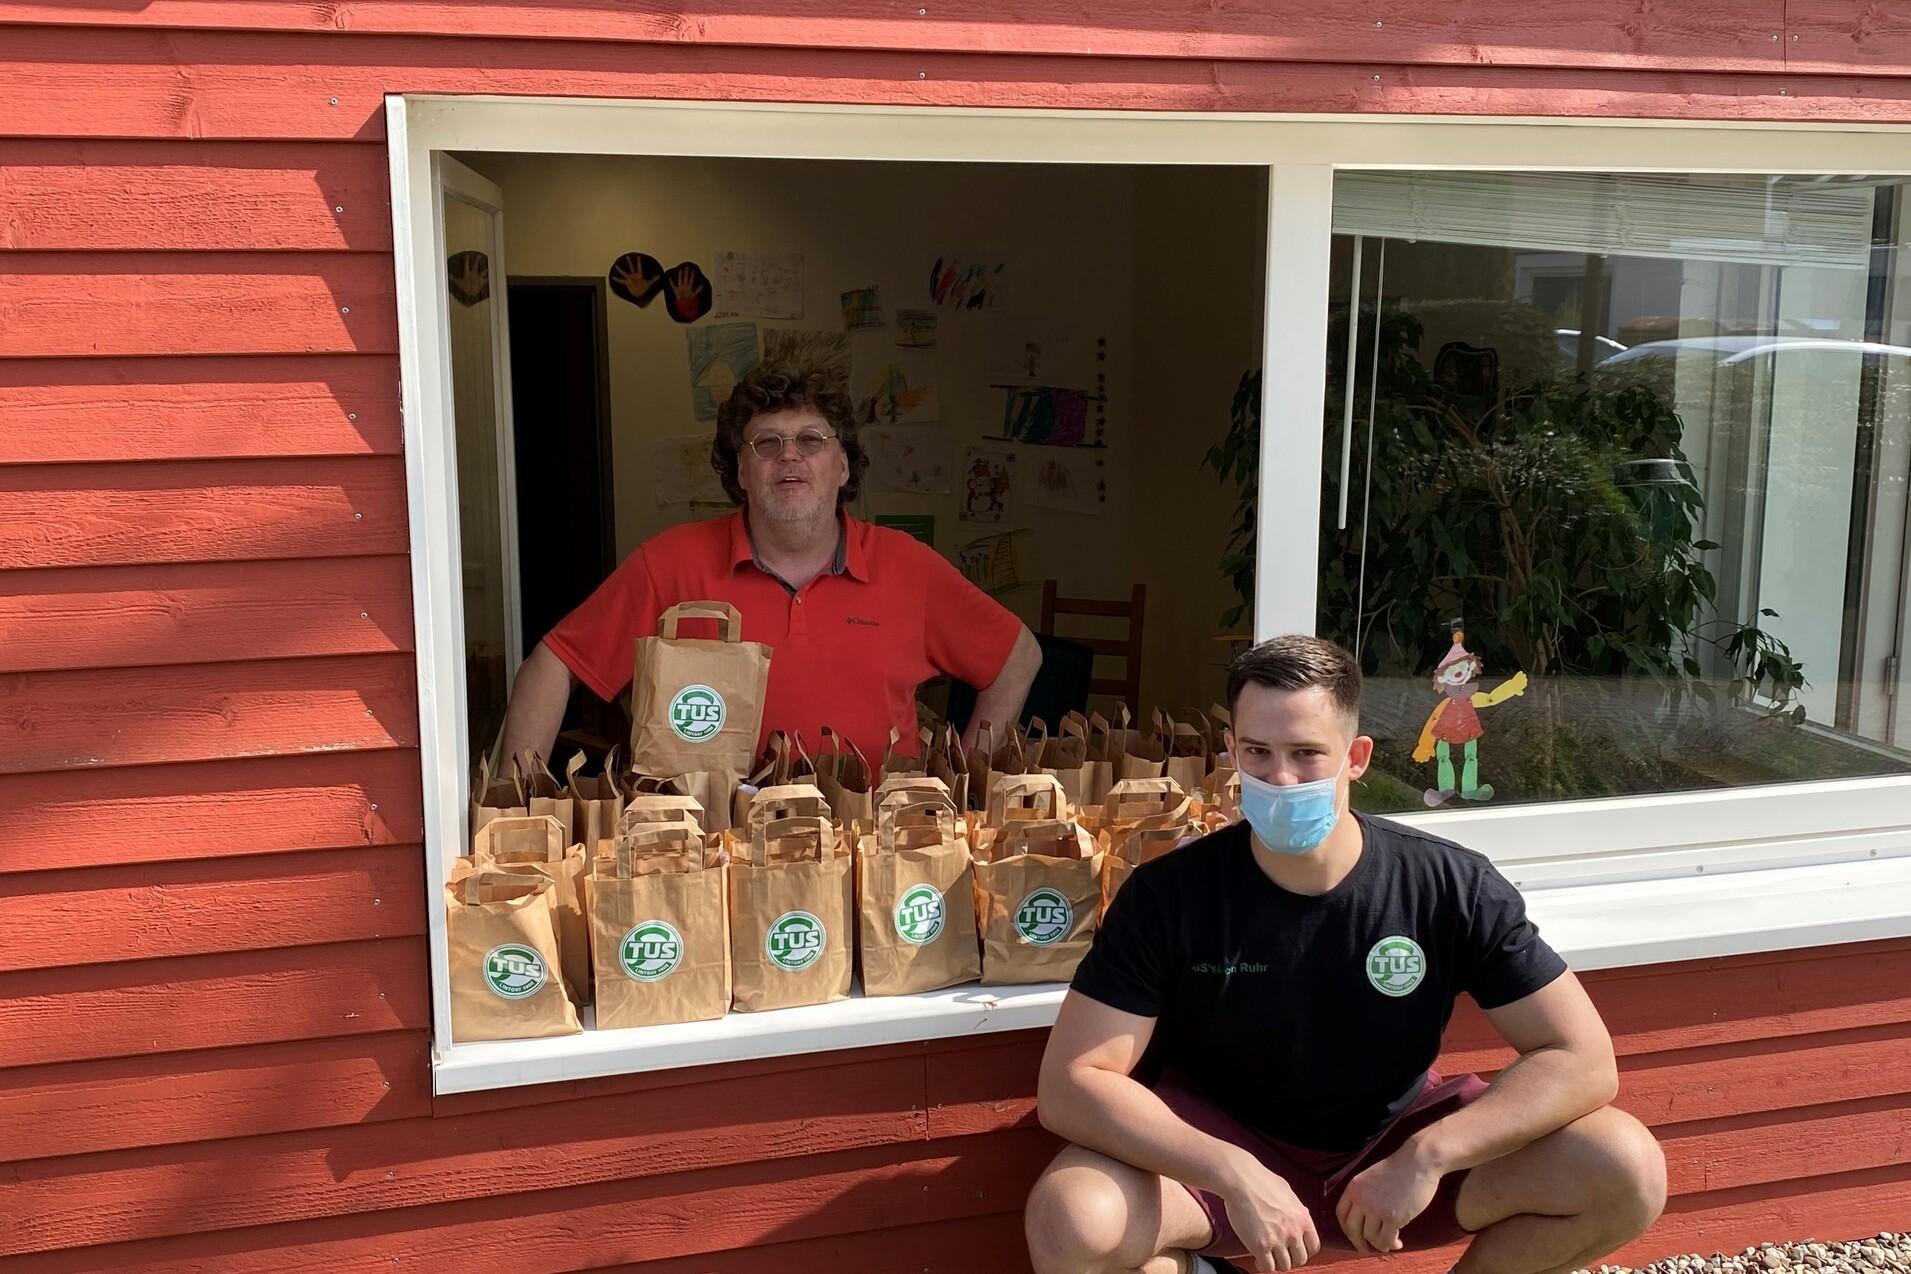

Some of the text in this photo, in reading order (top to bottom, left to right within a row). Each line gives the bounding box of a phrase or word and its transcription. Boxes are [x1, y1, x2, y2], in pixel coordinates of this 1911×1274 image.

[677, 704, 719, 721] TUS
[901, 901, 940, 925] TUS
[1023, 907, 1066, 924] TUS
[773, 931, 819, 949] TUS
[628, 942, 676, 959] TUS
[493, 957, 541, 977] TUS
[1240, 962, 1268, 973] Ruhr
[1374, 956, 1420, 973] TUS
